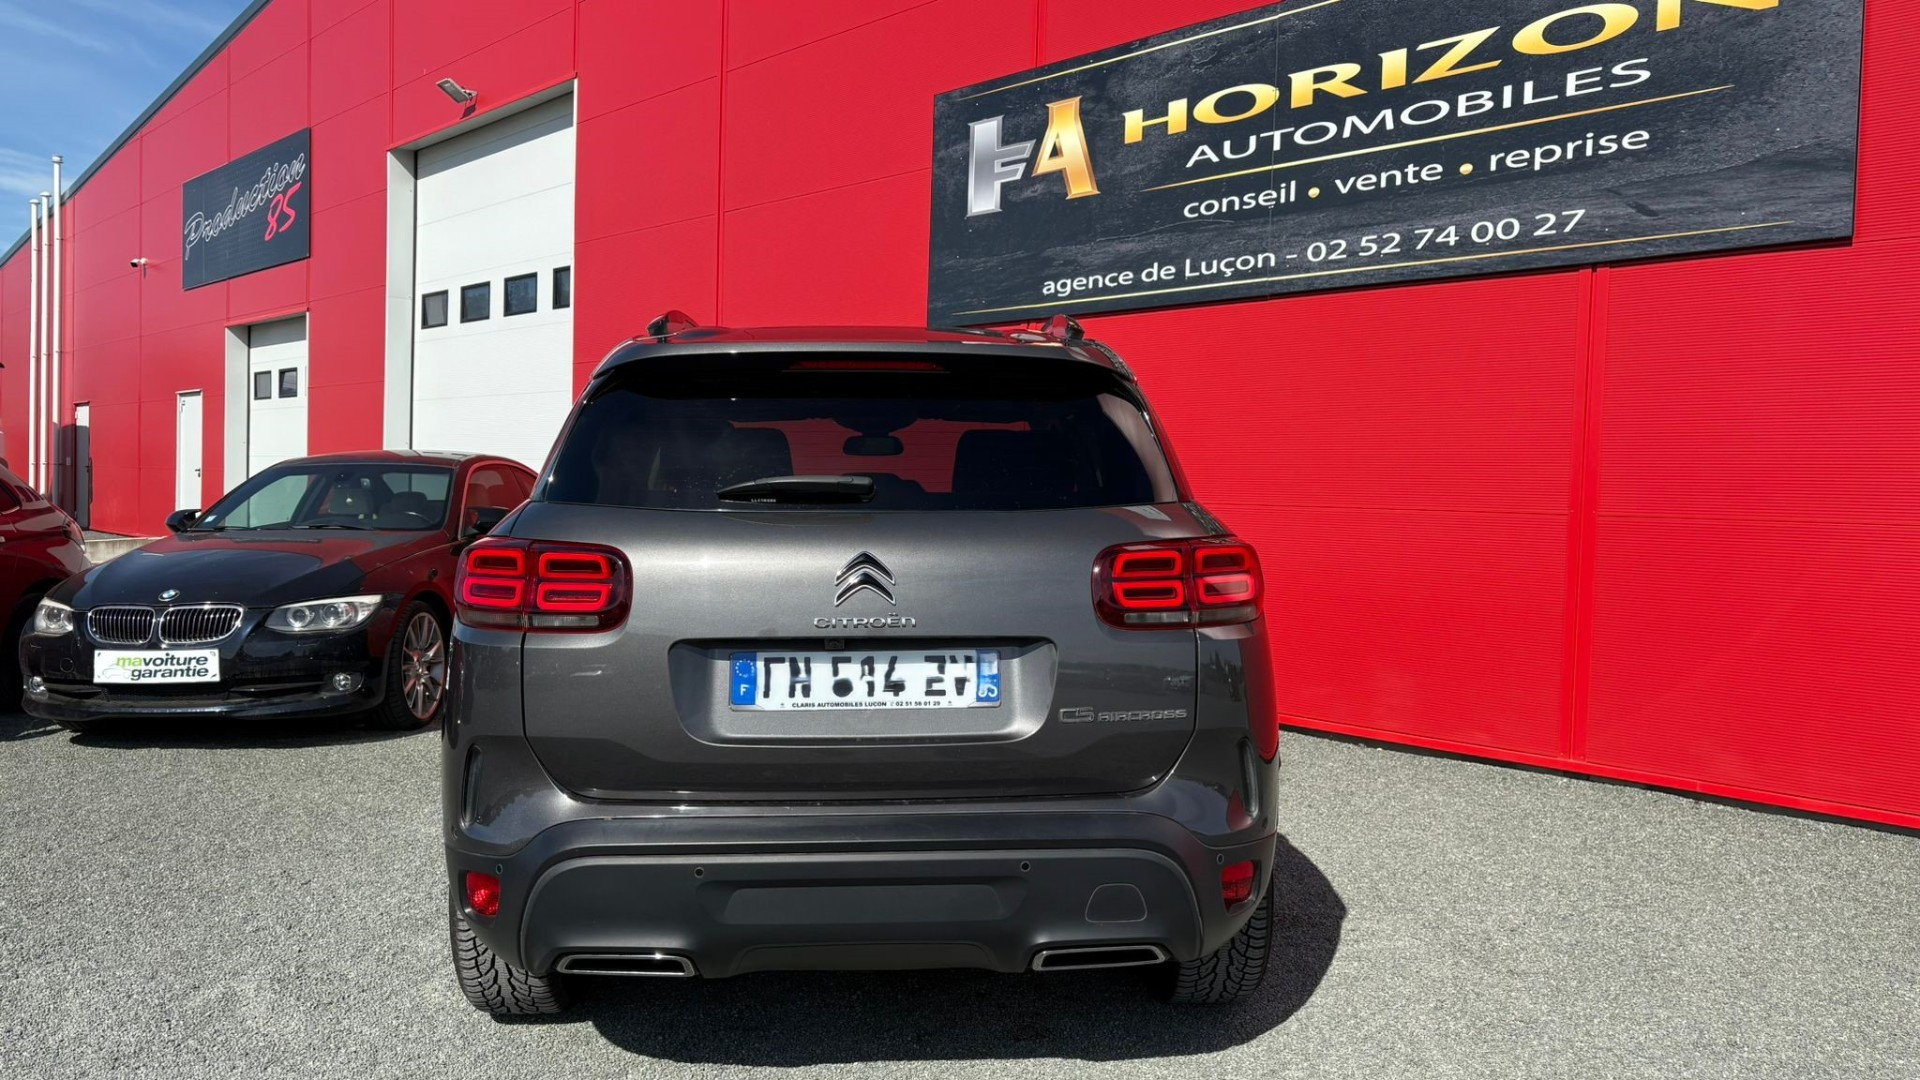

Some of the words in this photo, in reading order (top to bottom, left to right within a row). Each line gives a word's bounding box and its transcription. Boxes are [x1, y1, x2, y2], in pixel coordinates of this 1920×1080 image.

[1185, 57, 1652, 168] AUTOMOBILES
[184, 152, 306, 261] Production
[264, 181, 302, 242] 85
[1183, 181, 1296, 219] conseil
[1334, 163, 1444, 194] vente
[1489, 130, 1651, 171] reprise
[1042, 271, 1134, 297] agence
[1141, 261, 1176, 283] de
[1184, 250, 1276, 278] Luçon
[1307, 239, 1347, 263] 02
[1358, 231, 1401, 256] 52
[1414, 225, 1460, 250] 74
[1470, 218, 1521, 244] 00
[1532, 209, 1586, 237] 27
[116, 652, 209, 668] mavoiture
[130, 665, 209, 681] garantie
